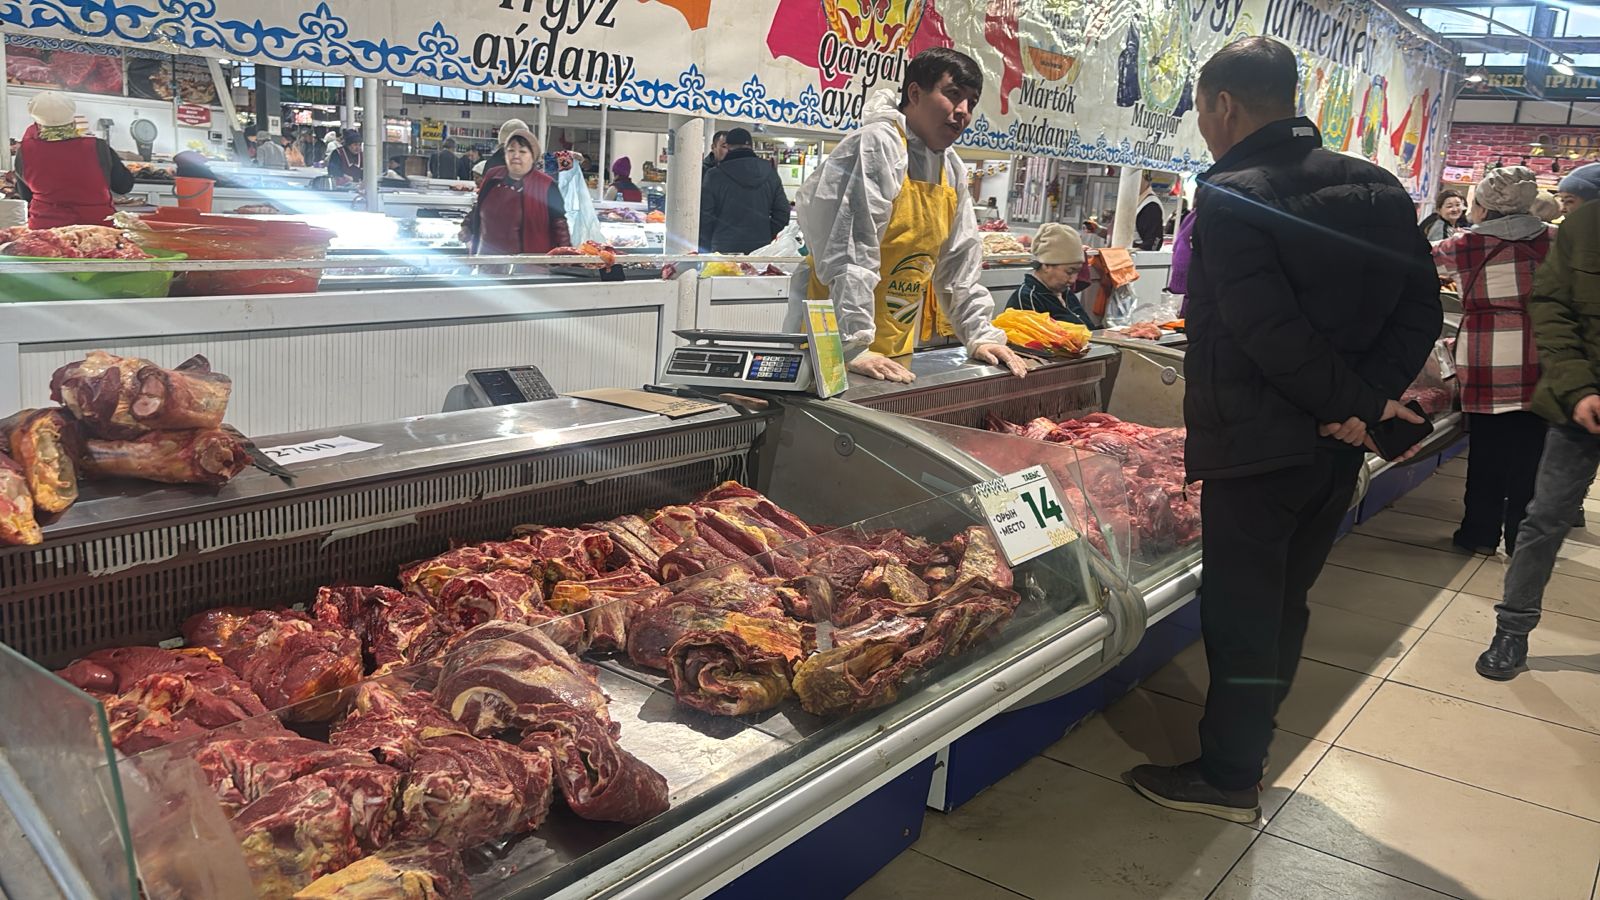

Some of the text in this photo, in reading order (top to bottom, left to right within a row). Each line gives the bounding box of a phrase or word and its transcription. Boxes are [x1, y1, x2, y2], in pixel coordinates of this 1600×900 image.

[472, 23, 634, 99] aýdany
[1018, 78, 1077, 114] Mártók
[264, 443, 336, 457] 2700
[1020, 486, 1064, 529] 14
[1001, 520, 1026, 536] МЕСТО
